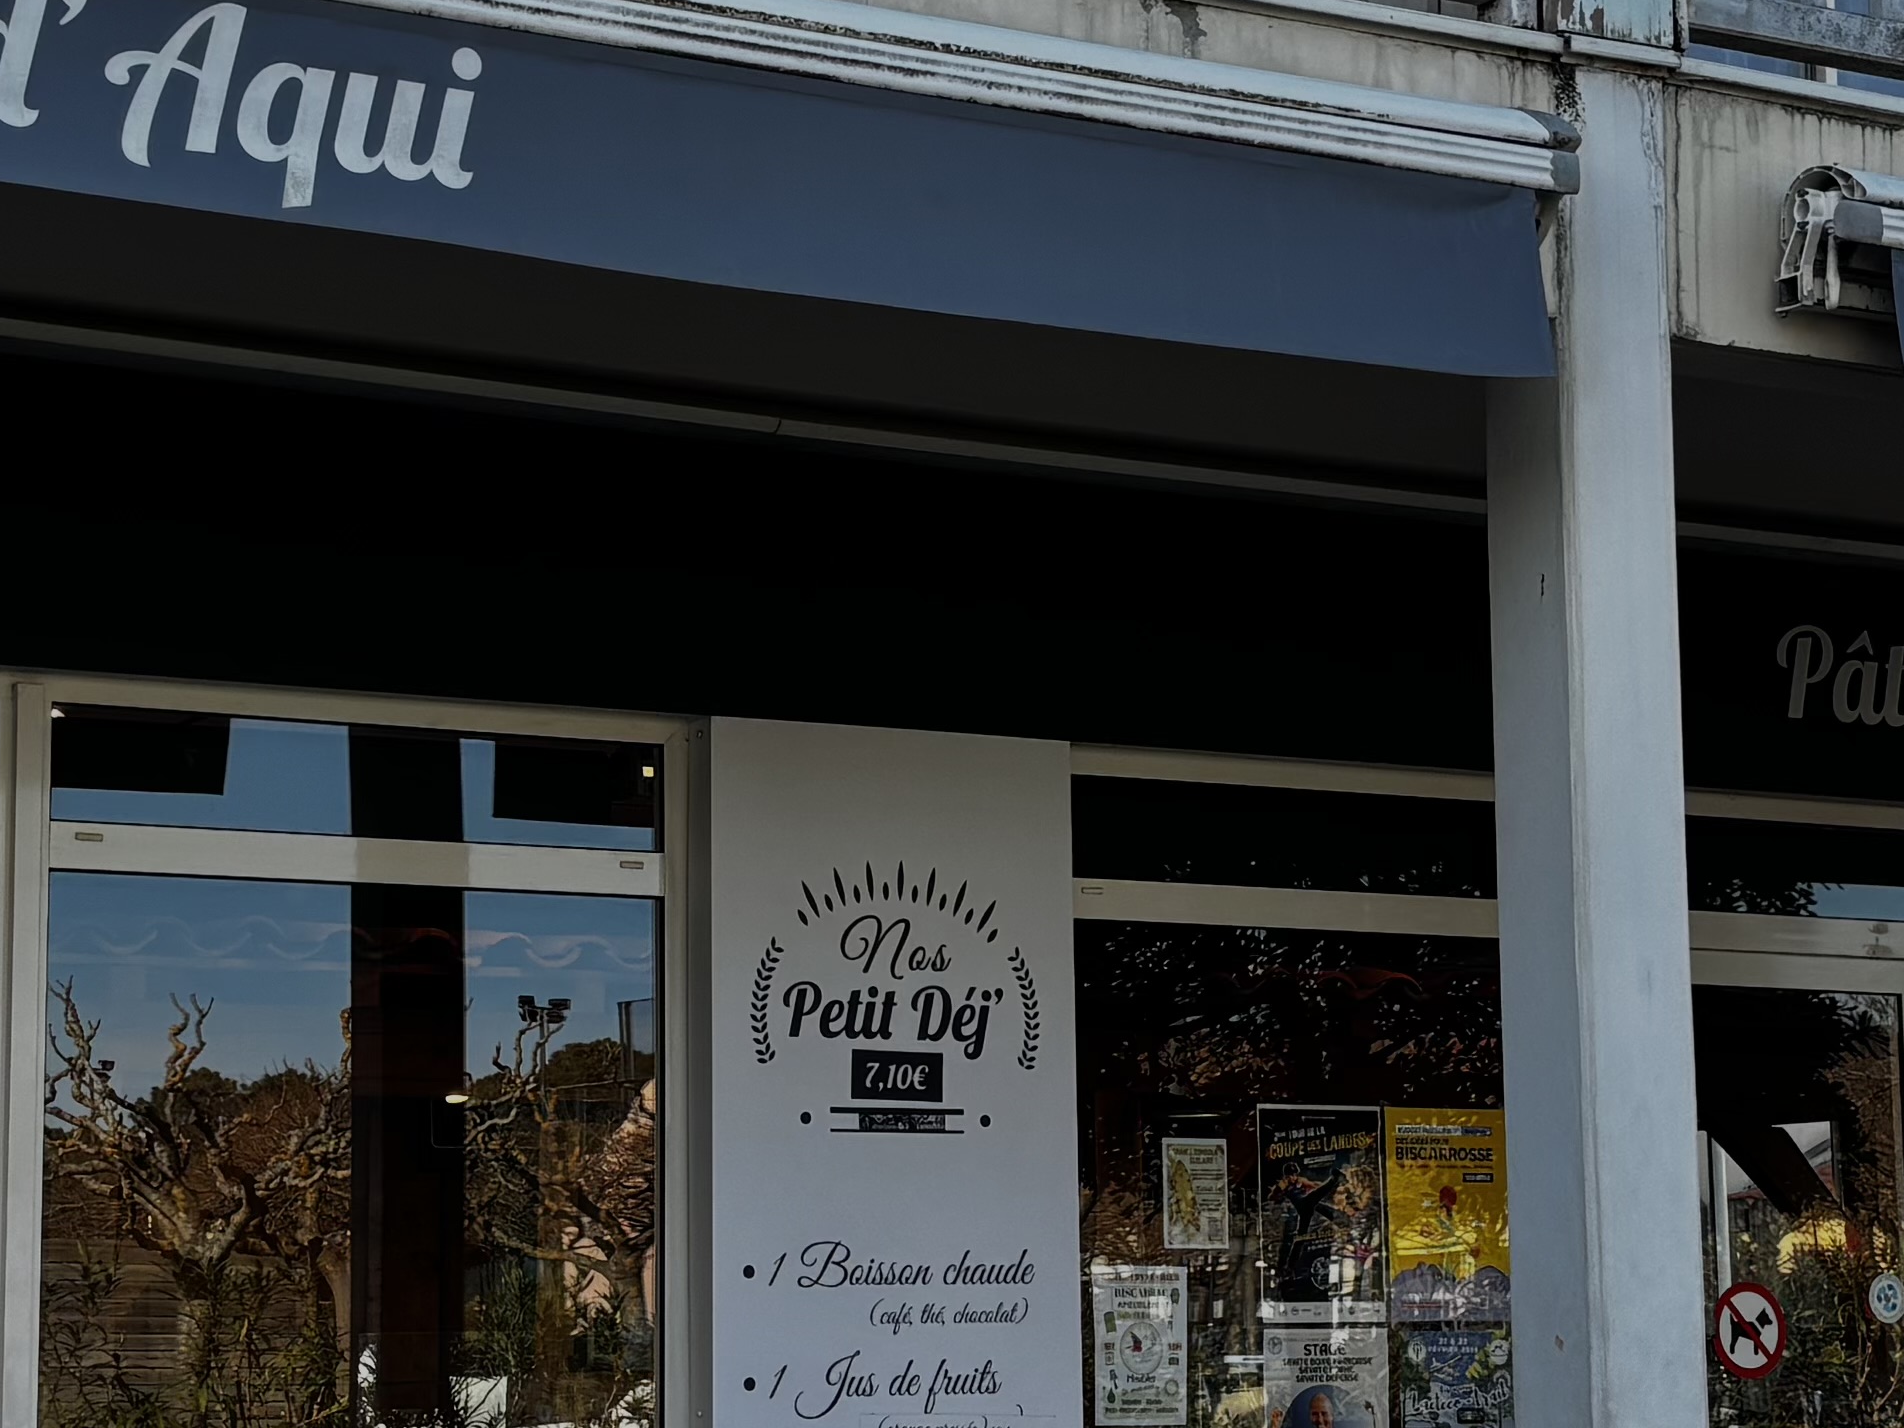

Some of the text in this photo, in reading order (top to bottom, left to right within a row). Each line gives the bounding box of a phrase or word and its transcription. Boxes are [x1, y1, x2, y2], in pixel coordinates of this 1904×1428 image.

[840, 914, 952, 980] Nos
[783, 981, 897, 1040] Petit
[864, 1061, 930, 1092] 7,10€
[1269, 1139, 1306, 1160] COUPE
[1323, 1131, 1370, 1153] LANDES
[1395, 1146, 1494, 1162] BISCARROSSE
[769, 1241, 1036, 1288] 1 Boisson chaude
[920, 1302, 946, 1327] thé,
[953, 1297, 1030, 1325] chocolat)
[769, 1350, 1003, 1420] 1 Jus de fruits
